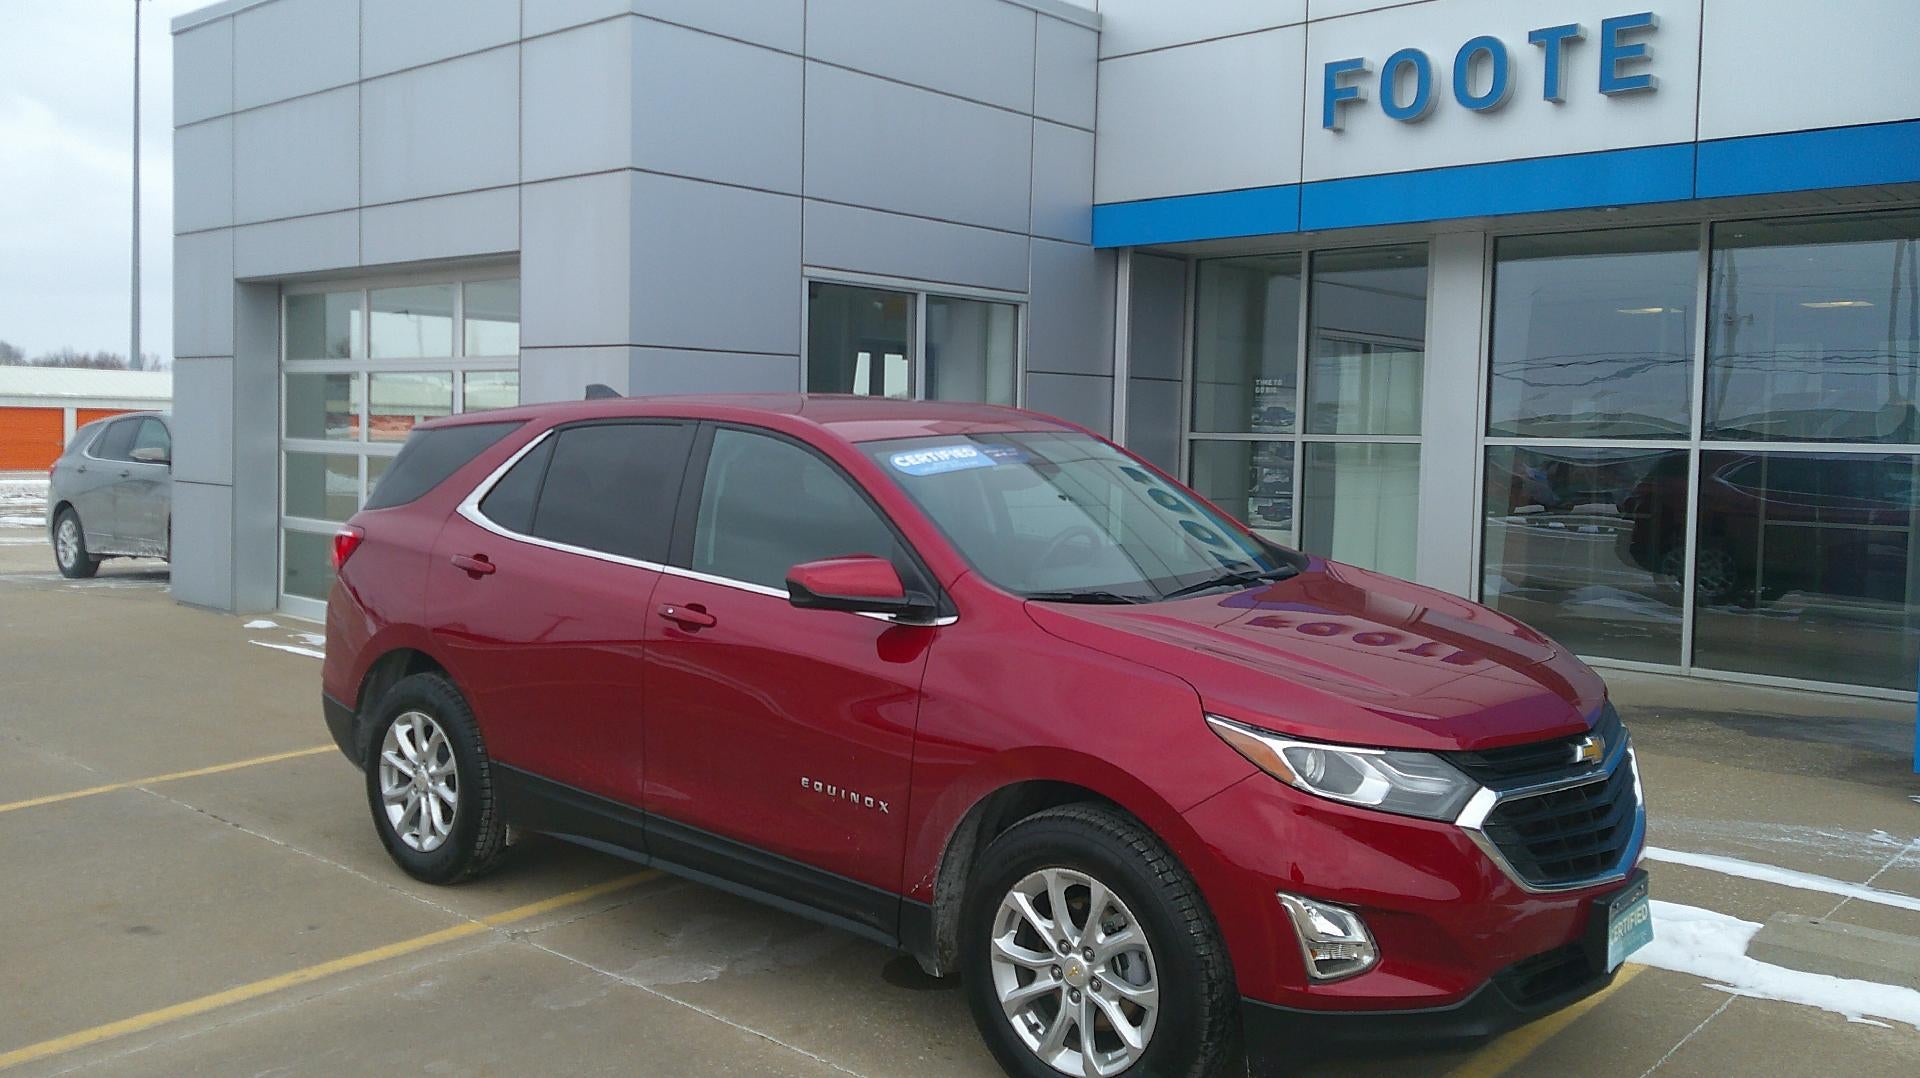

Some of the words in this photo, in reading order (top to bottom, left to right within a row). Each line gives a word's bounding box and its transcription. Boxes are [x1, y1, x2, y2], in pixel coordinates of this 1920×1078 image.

[1322, 11, 1656, 131] FOOTE
[894, 447, 978, 467] CERTIFIED
[801, 777, 889, 814] EQUINOX
